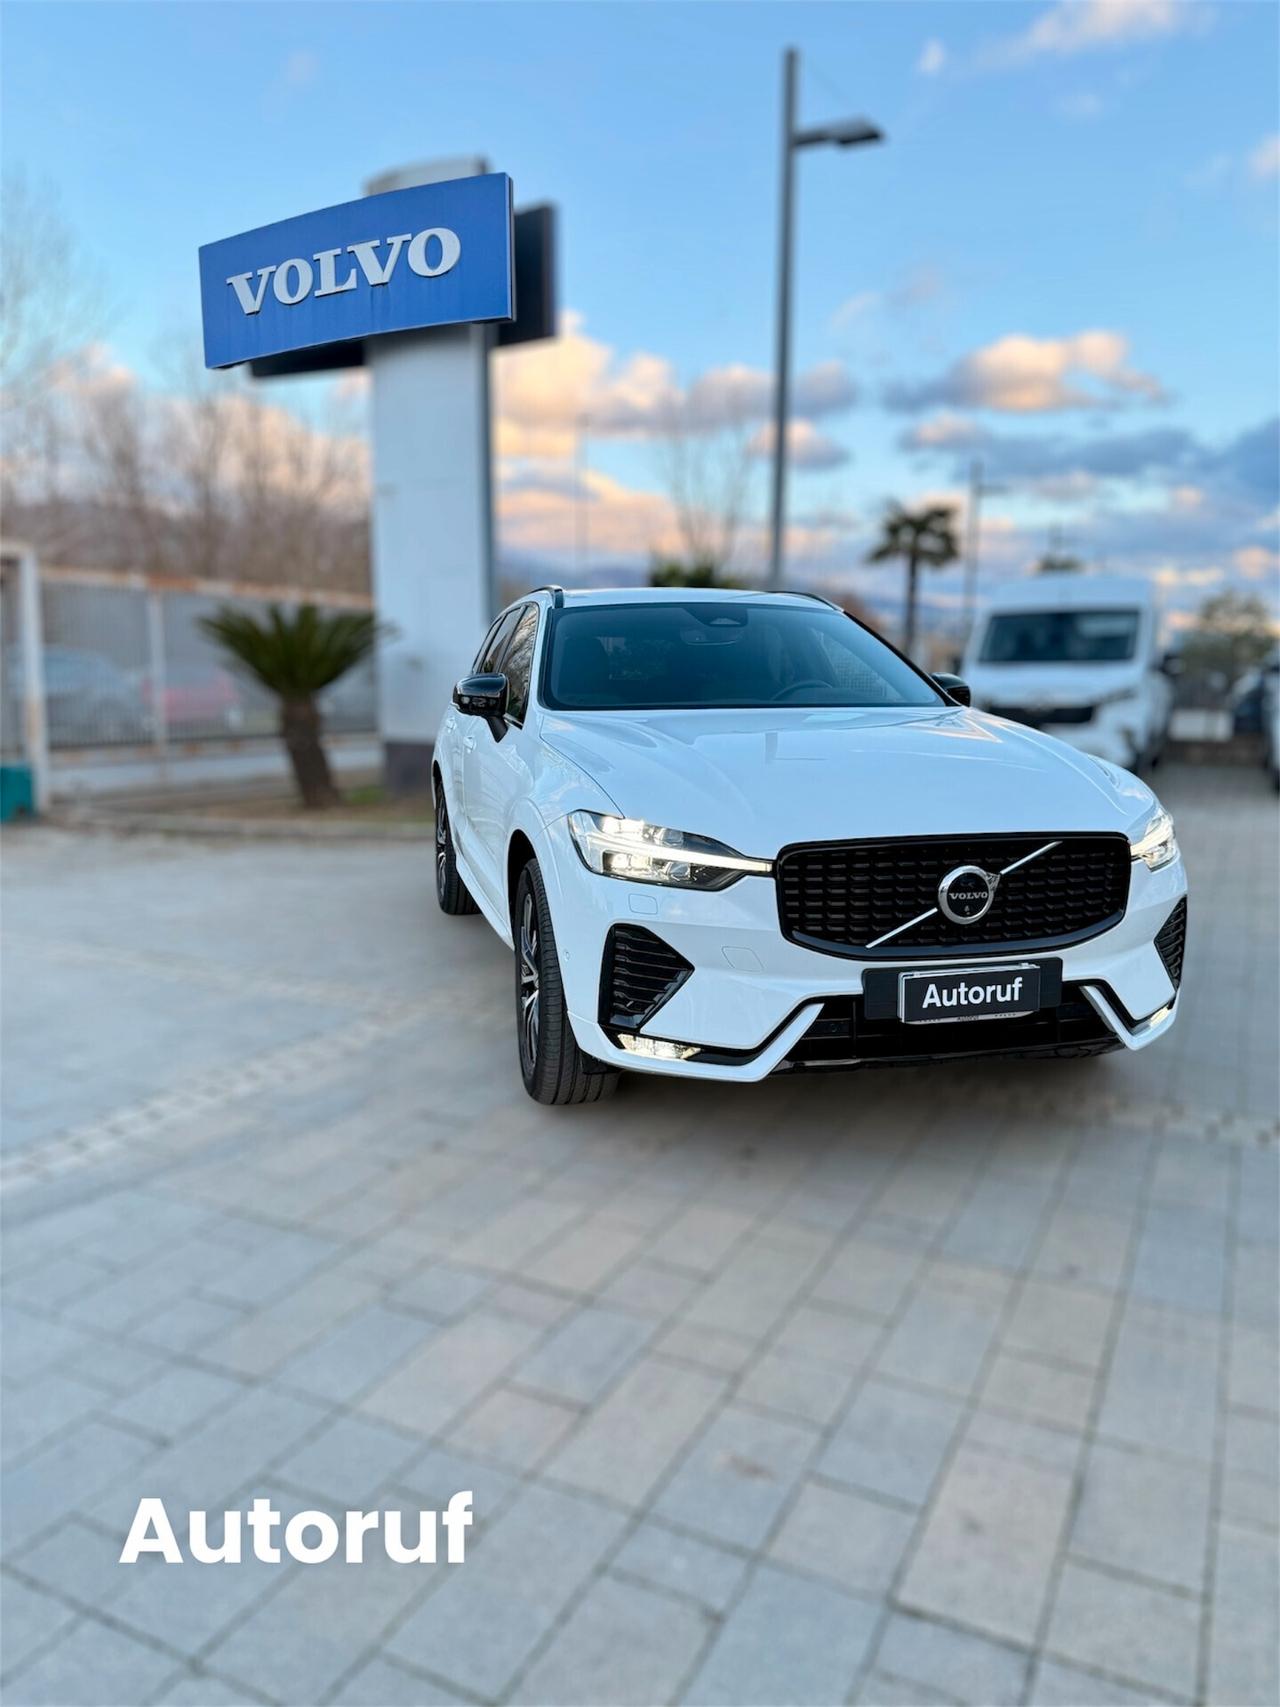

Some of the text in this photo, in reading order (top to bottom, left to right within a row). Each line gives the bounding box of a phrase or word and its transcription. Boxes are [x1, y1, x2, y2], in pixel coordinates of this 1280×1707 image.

[226, 227, 461, 315] VOLVO
[949, 891, 988, 900] VOLVO
[922, 977, 1023, 1008] Autoruf
